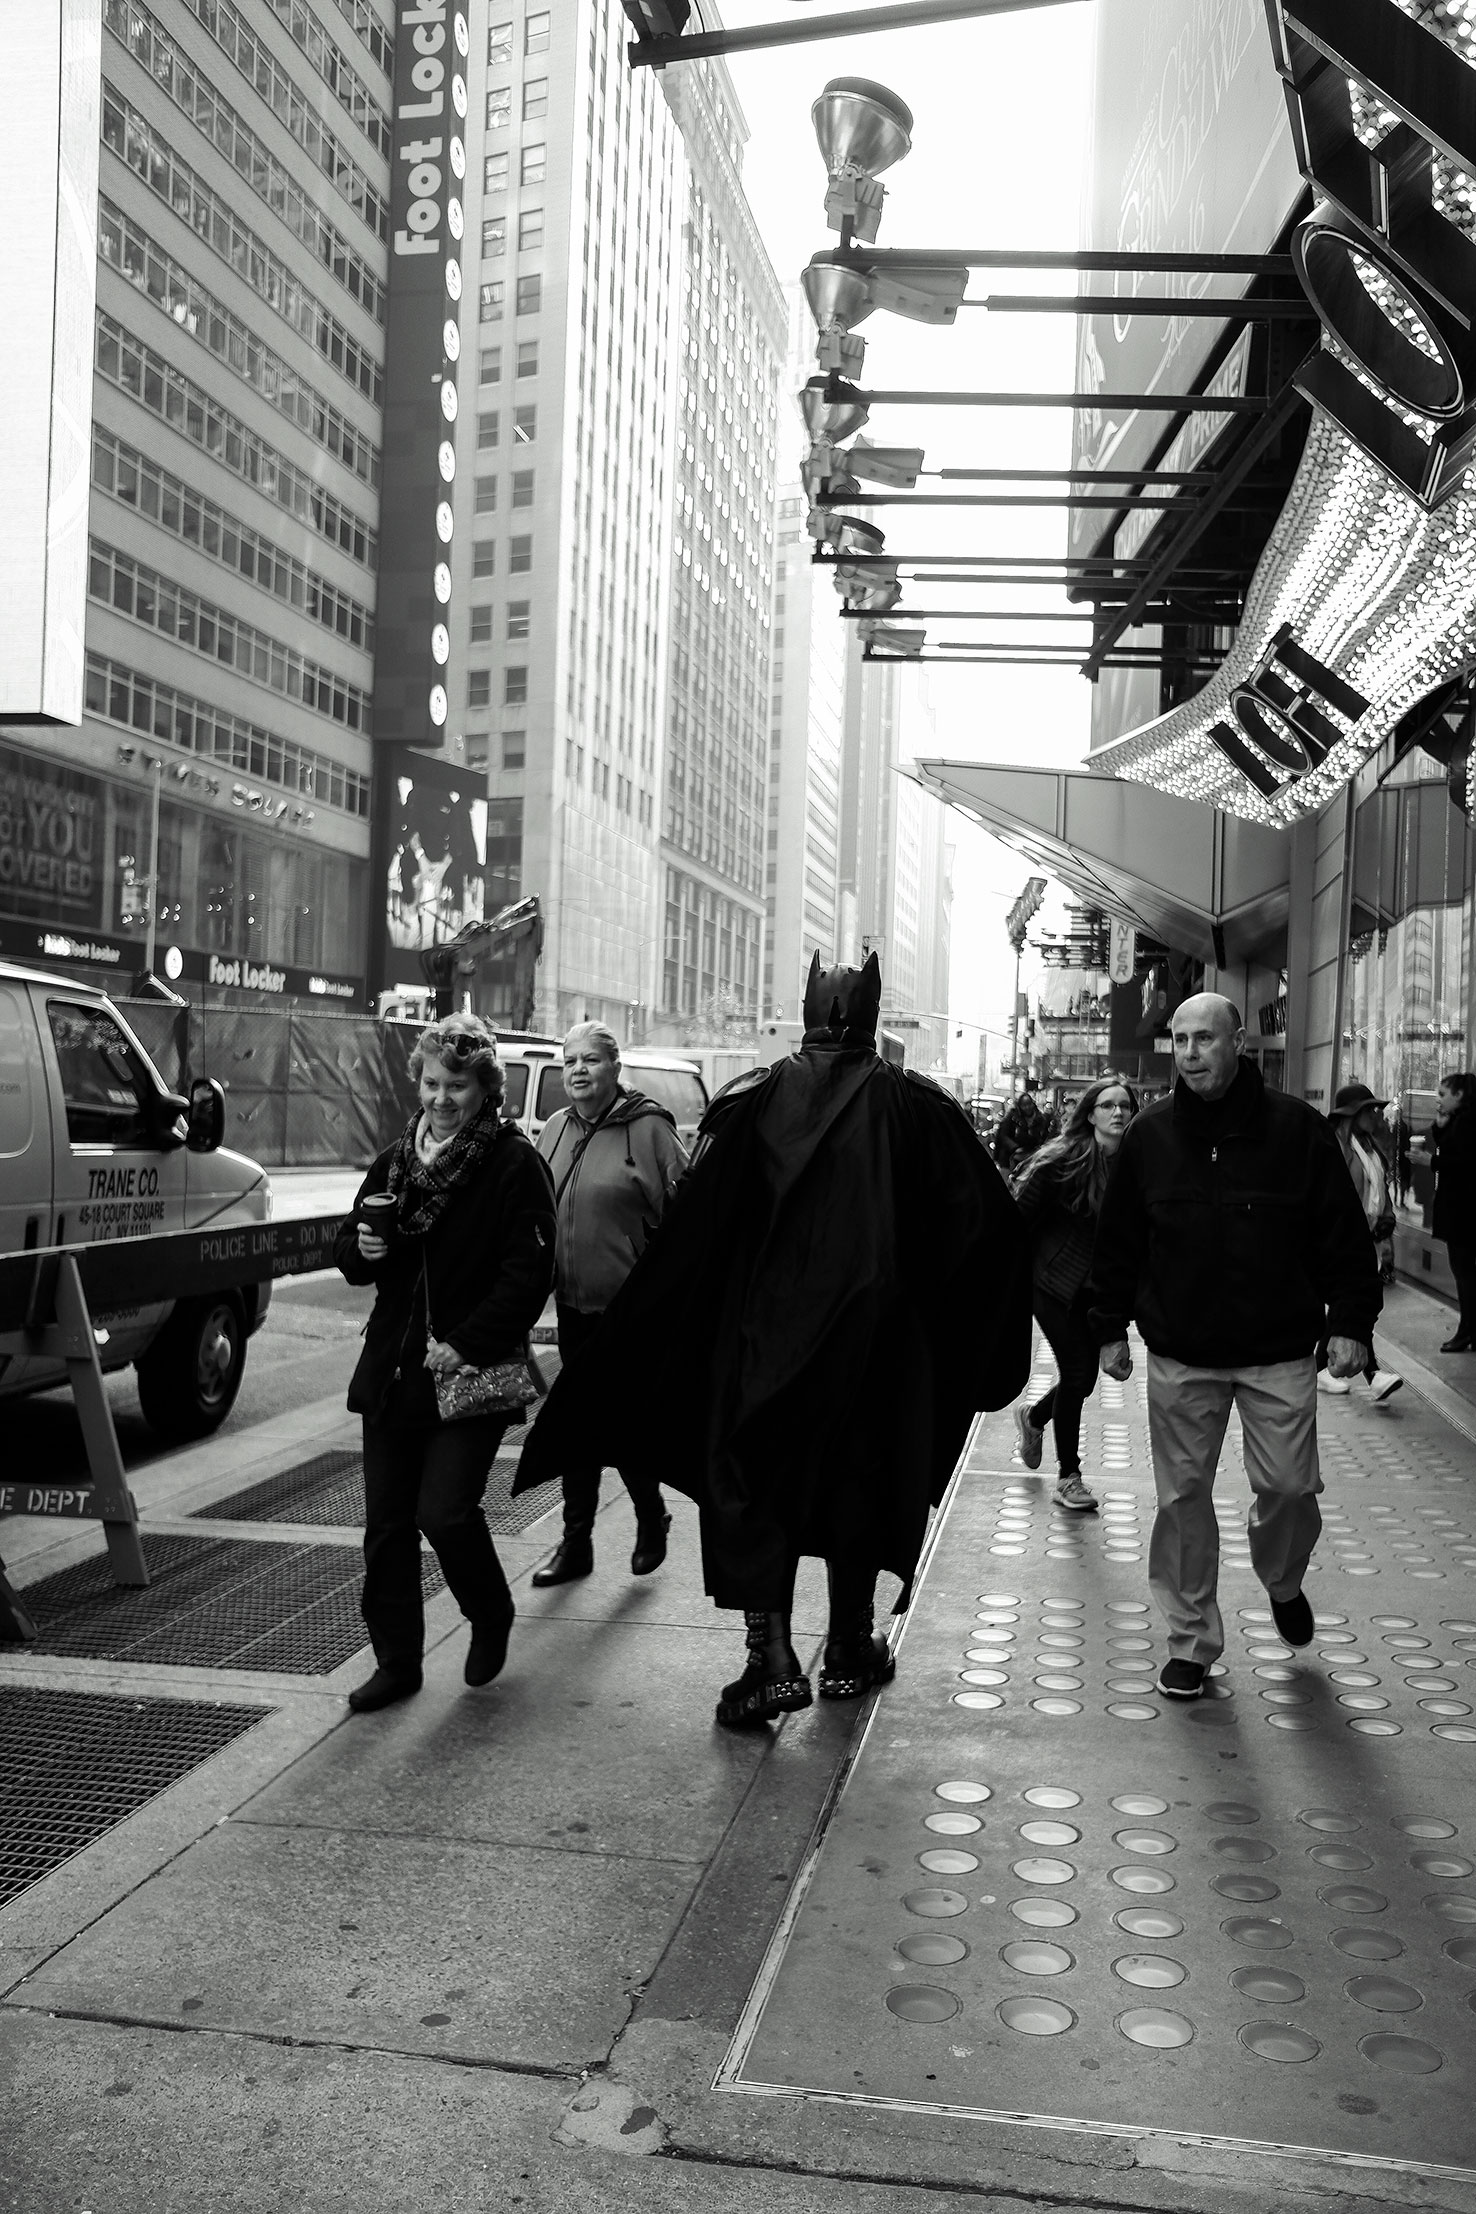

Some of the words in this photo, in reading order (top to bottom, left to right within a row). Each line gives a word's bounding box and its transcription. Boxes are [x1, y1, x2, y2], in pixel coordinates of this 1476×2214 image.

[27, 800, 94, 863] YOU
[209, 954, 241, 988] Foot
[242, 960, 287, 994] Locker
[88, 1168, 136, 1199] TRANE
[138, 1166, 160, 1197] CO.
[102, 1202, 132, 1224] COURT
[132, 1199, 165, 1222] SQUARE
[200, 1234, 246, 1262] POLICE
[252, 1230, 279, 1255] LINE
[300, 1225, 316, 1246] DO
